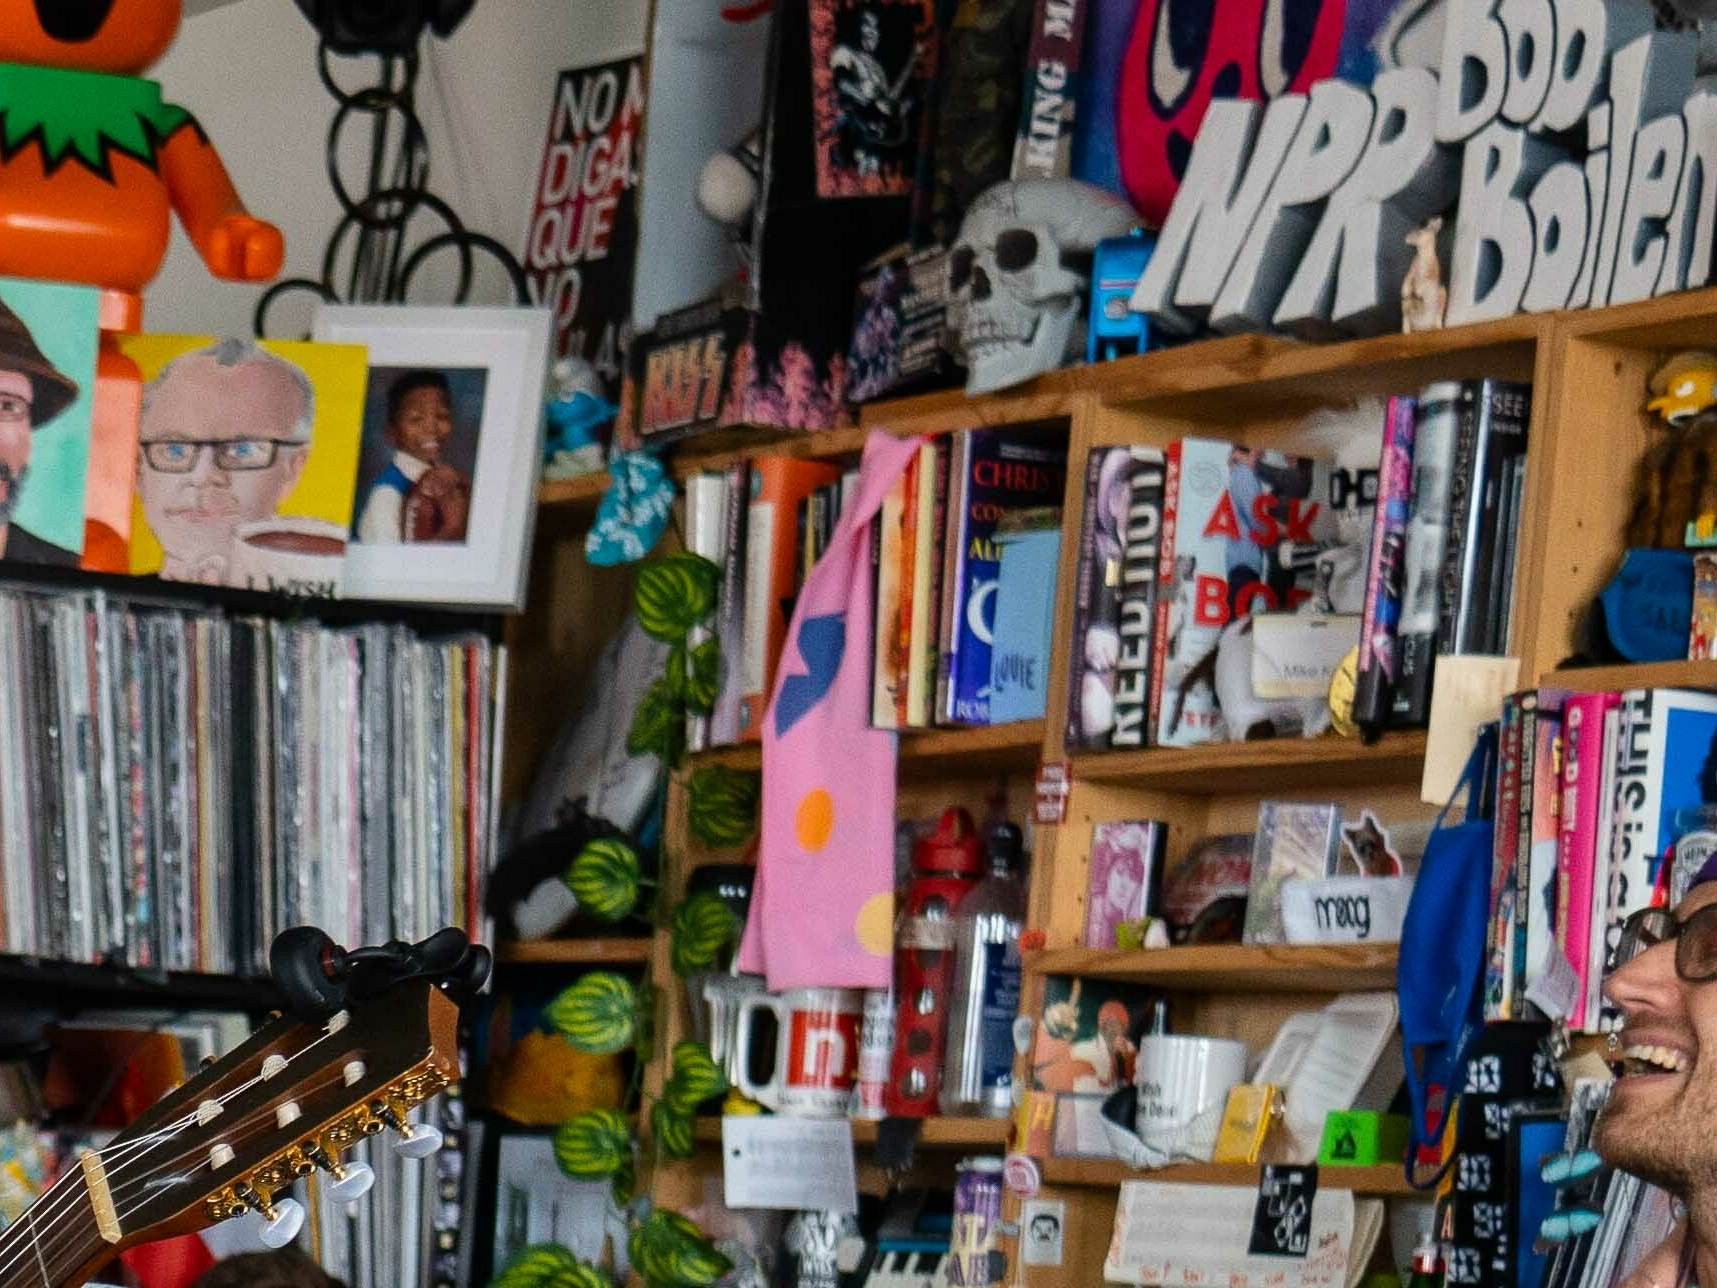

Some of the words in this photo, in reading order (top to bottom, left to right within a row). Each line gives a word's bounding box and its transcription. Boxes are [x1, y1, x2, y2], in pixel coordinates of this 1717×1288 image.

[557, 70, 617, 137] NO
[1436, 0, 1605, 142] Bob
[1131, 66, 1436, 330] NPR
[530, 197, 614, 270] QUE
[1199, 489, 1319, 548] ASK
[1625, 691, 1654, 812] THIS
[1314, 896, 1371, 938] moog
[802, 1025, 846, 1077] n
